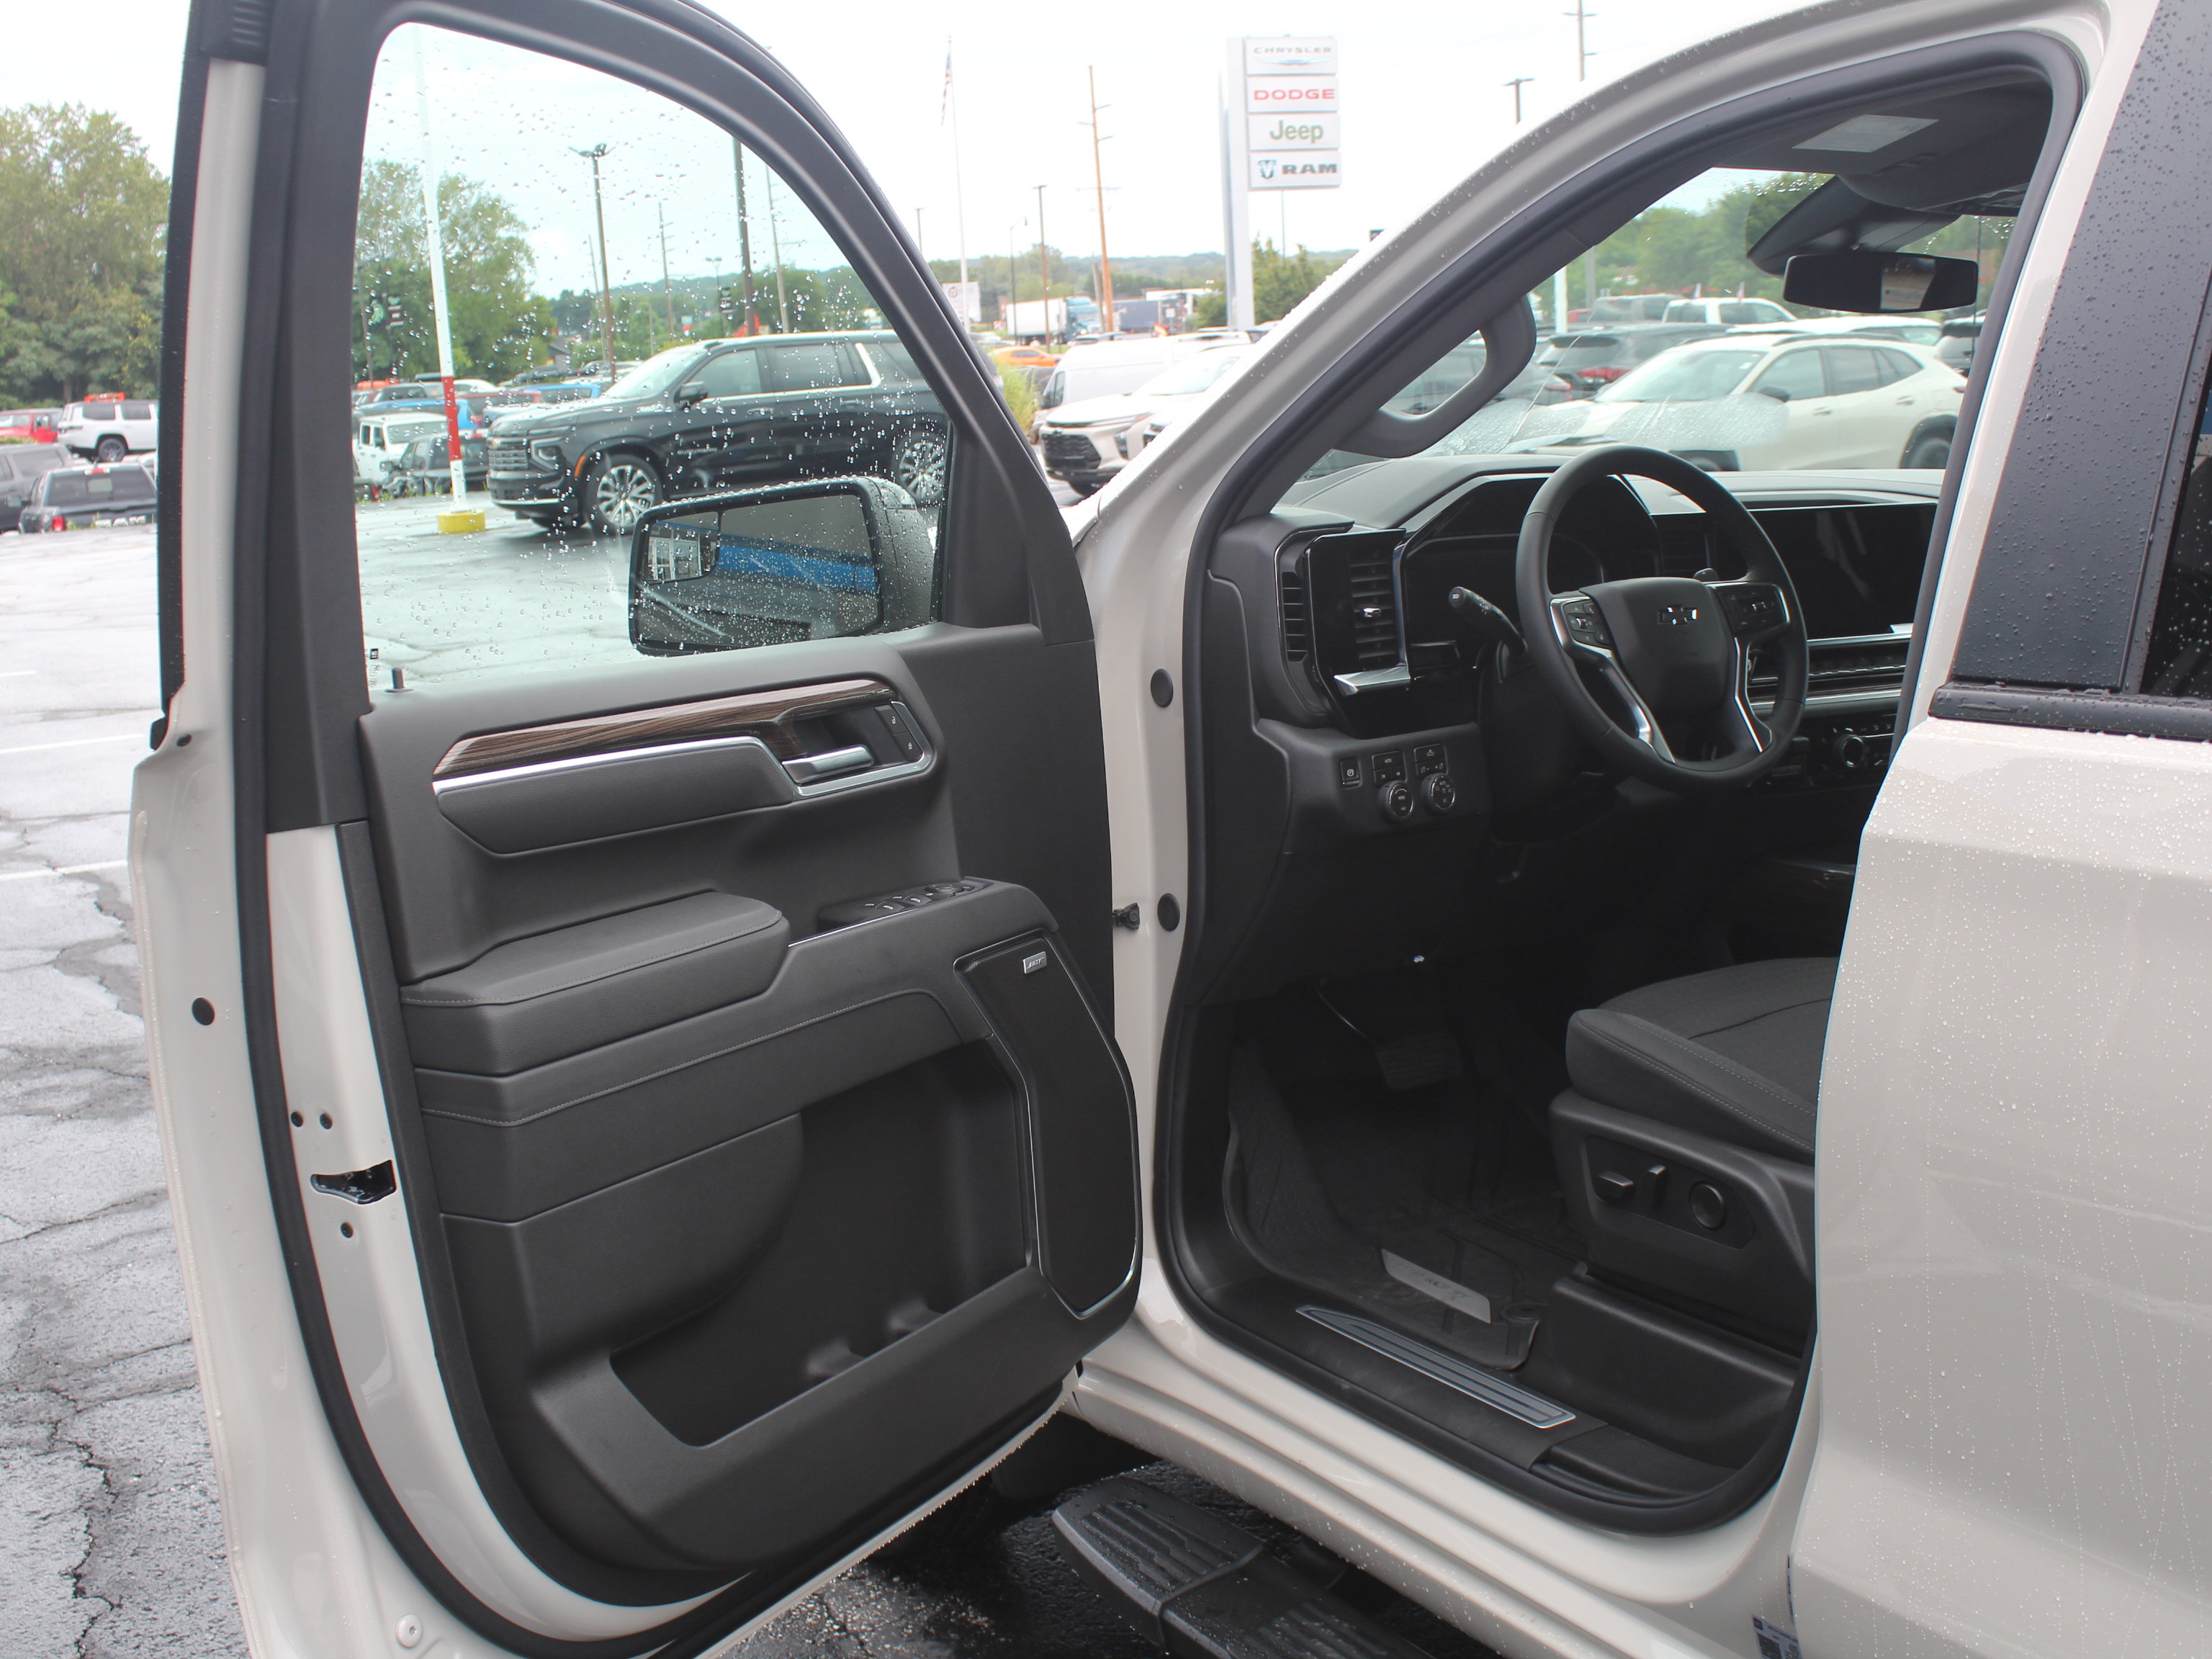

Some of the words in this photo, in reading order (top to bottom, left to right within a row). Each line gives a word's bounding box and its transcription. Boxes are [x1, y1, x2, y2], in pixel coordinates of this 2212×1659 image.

[1254, 89, 1335, 100] DODGE
[1269, 120, 1323, 144] Jeep
[1282, 163, 1338, 174] RAM
